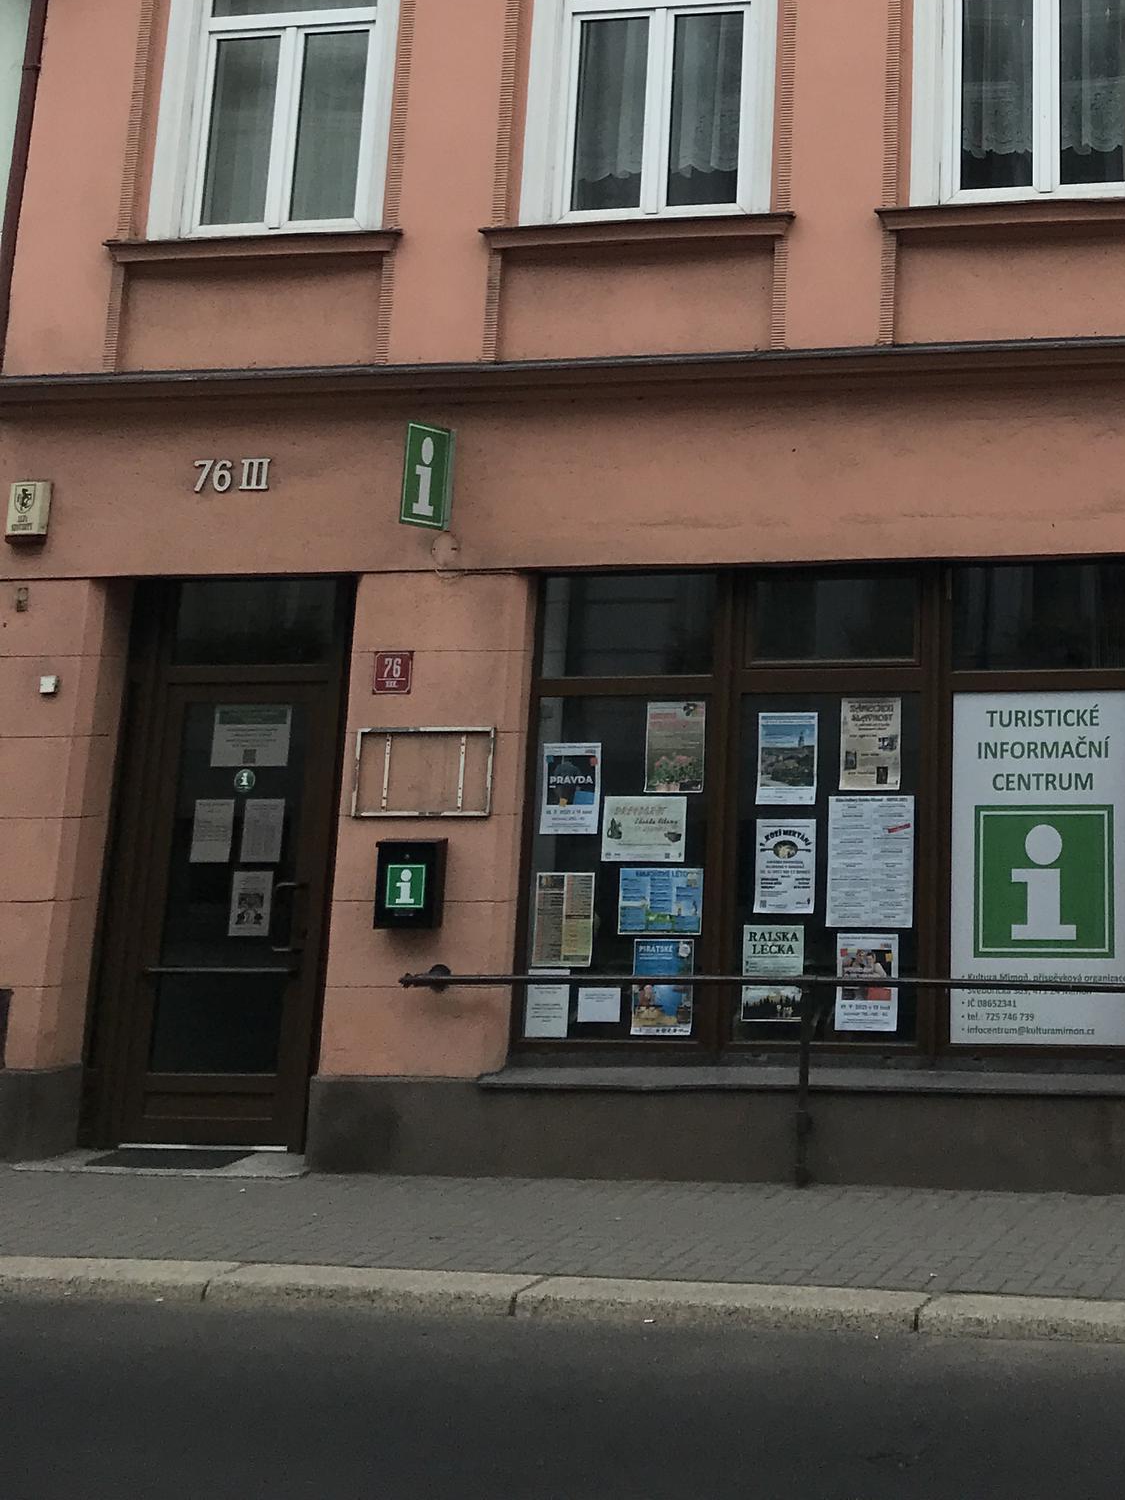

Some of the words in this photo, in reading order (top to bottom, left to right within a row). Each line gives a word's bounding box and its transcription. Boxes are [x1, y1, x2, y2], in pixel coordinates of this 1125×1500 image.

[193, 459, 233, 493] 76
[238, 458, 271, 491] III
[383, 657, 402, 678] 76
[986, 704, 1100, 728] TURISTICKÉ
[977, 735, 1111, 760] INFORMAČNÍ
[549, 775, 594, 785] PRAVDA
[992, 772, 1094, 791] CENTRUM
[977, 999, 1017, 1008] 08652341
[985, 1012, 1001, 1021] 725
[1019, 1013, 1035, 1022] 739
